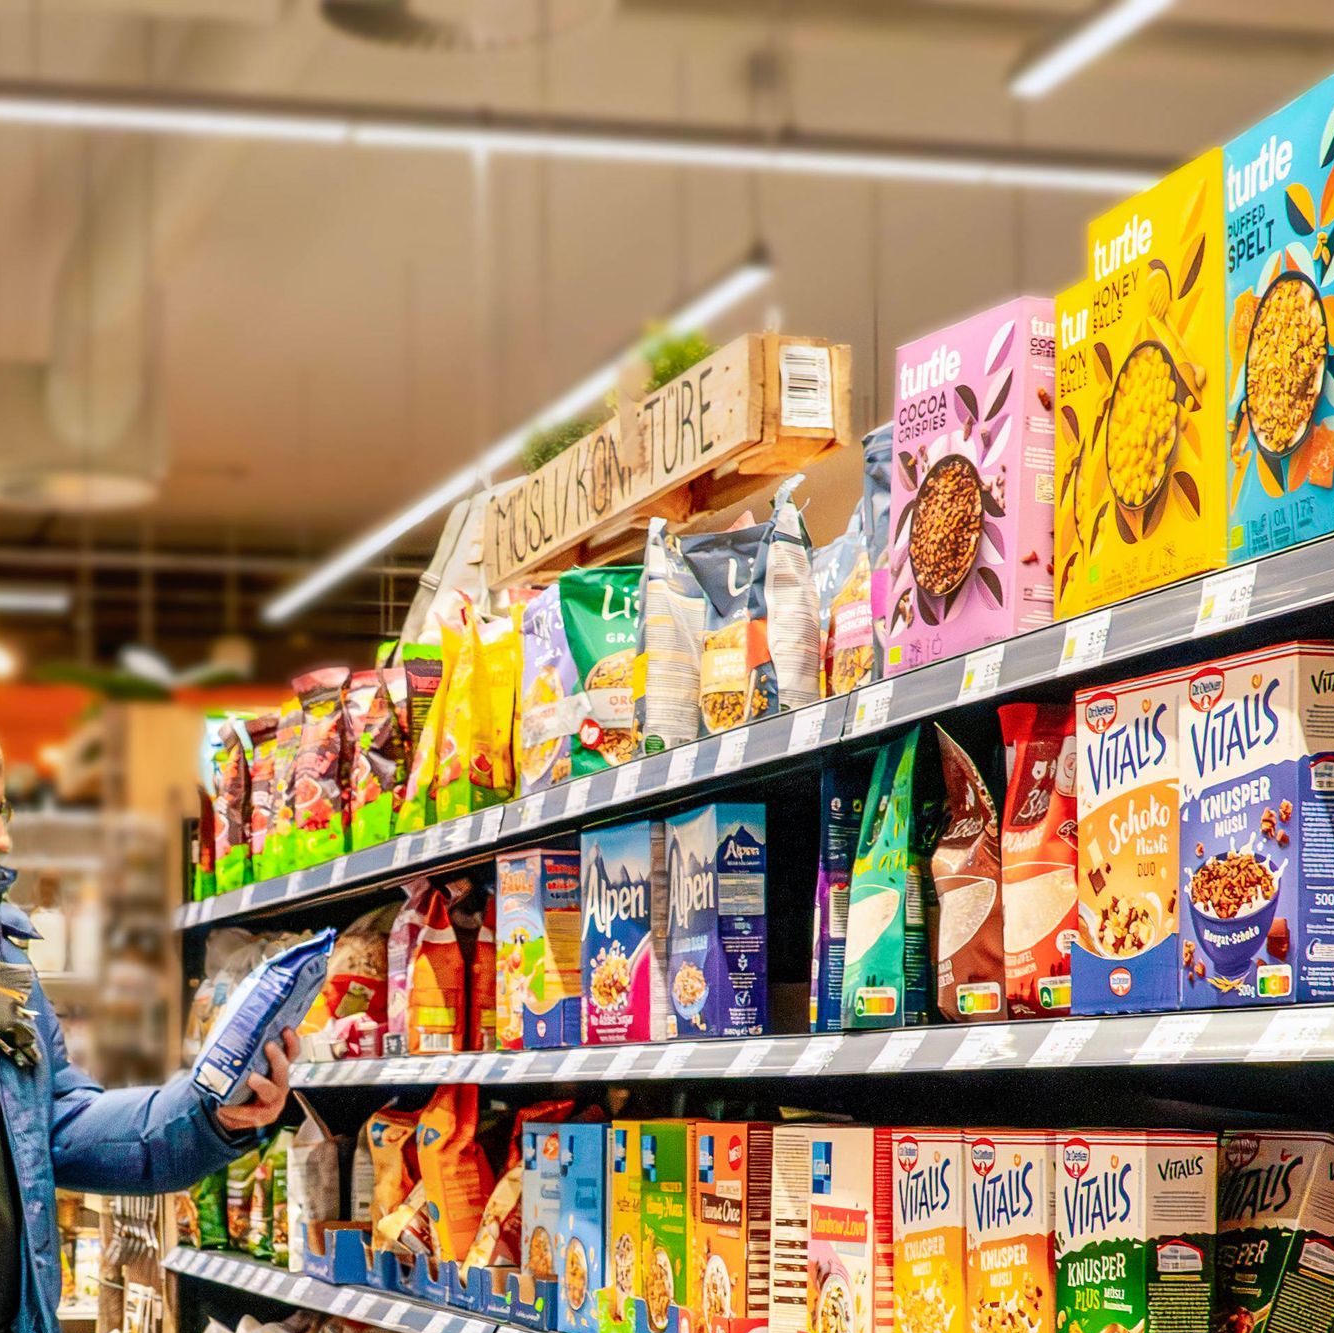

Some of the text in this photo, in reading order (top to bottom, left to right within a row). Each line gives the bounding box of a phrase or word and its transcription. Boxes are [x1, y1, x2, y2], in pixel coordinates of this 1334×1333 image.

[1225, 135, 1294, 213] turtle
[1226, 203, 1267, 242] PUFFED
[1092, 214, 1153, 284] turtle
[1226, 220, 1276, 277] SPELT
[1092, 267, 1142, 312] HONEY
[1092, 301, 1125, 337] BALLS
[898, 345, 961, 399] turtle
[897, 390, 948, 428] COCOA
[897, 409, 948, 446] CRISPIES
[1199, 775, 1273, 825] KNUSPER
[1107, 794, 1173, 856] Schoko
[1213, 812, 1249, 839] MÜSLI
[581, 861, 648, 942] Alpen
[667, 847, 716, 939] Alpen
[903, 1233, 947, 1263] KNUSPER
[979, 1243, 1029, 1274] KNUSPER
[1067, 1251, 1127, 1292] KNUSPER
[1073, 1288, 1100, 1312] PLUS
